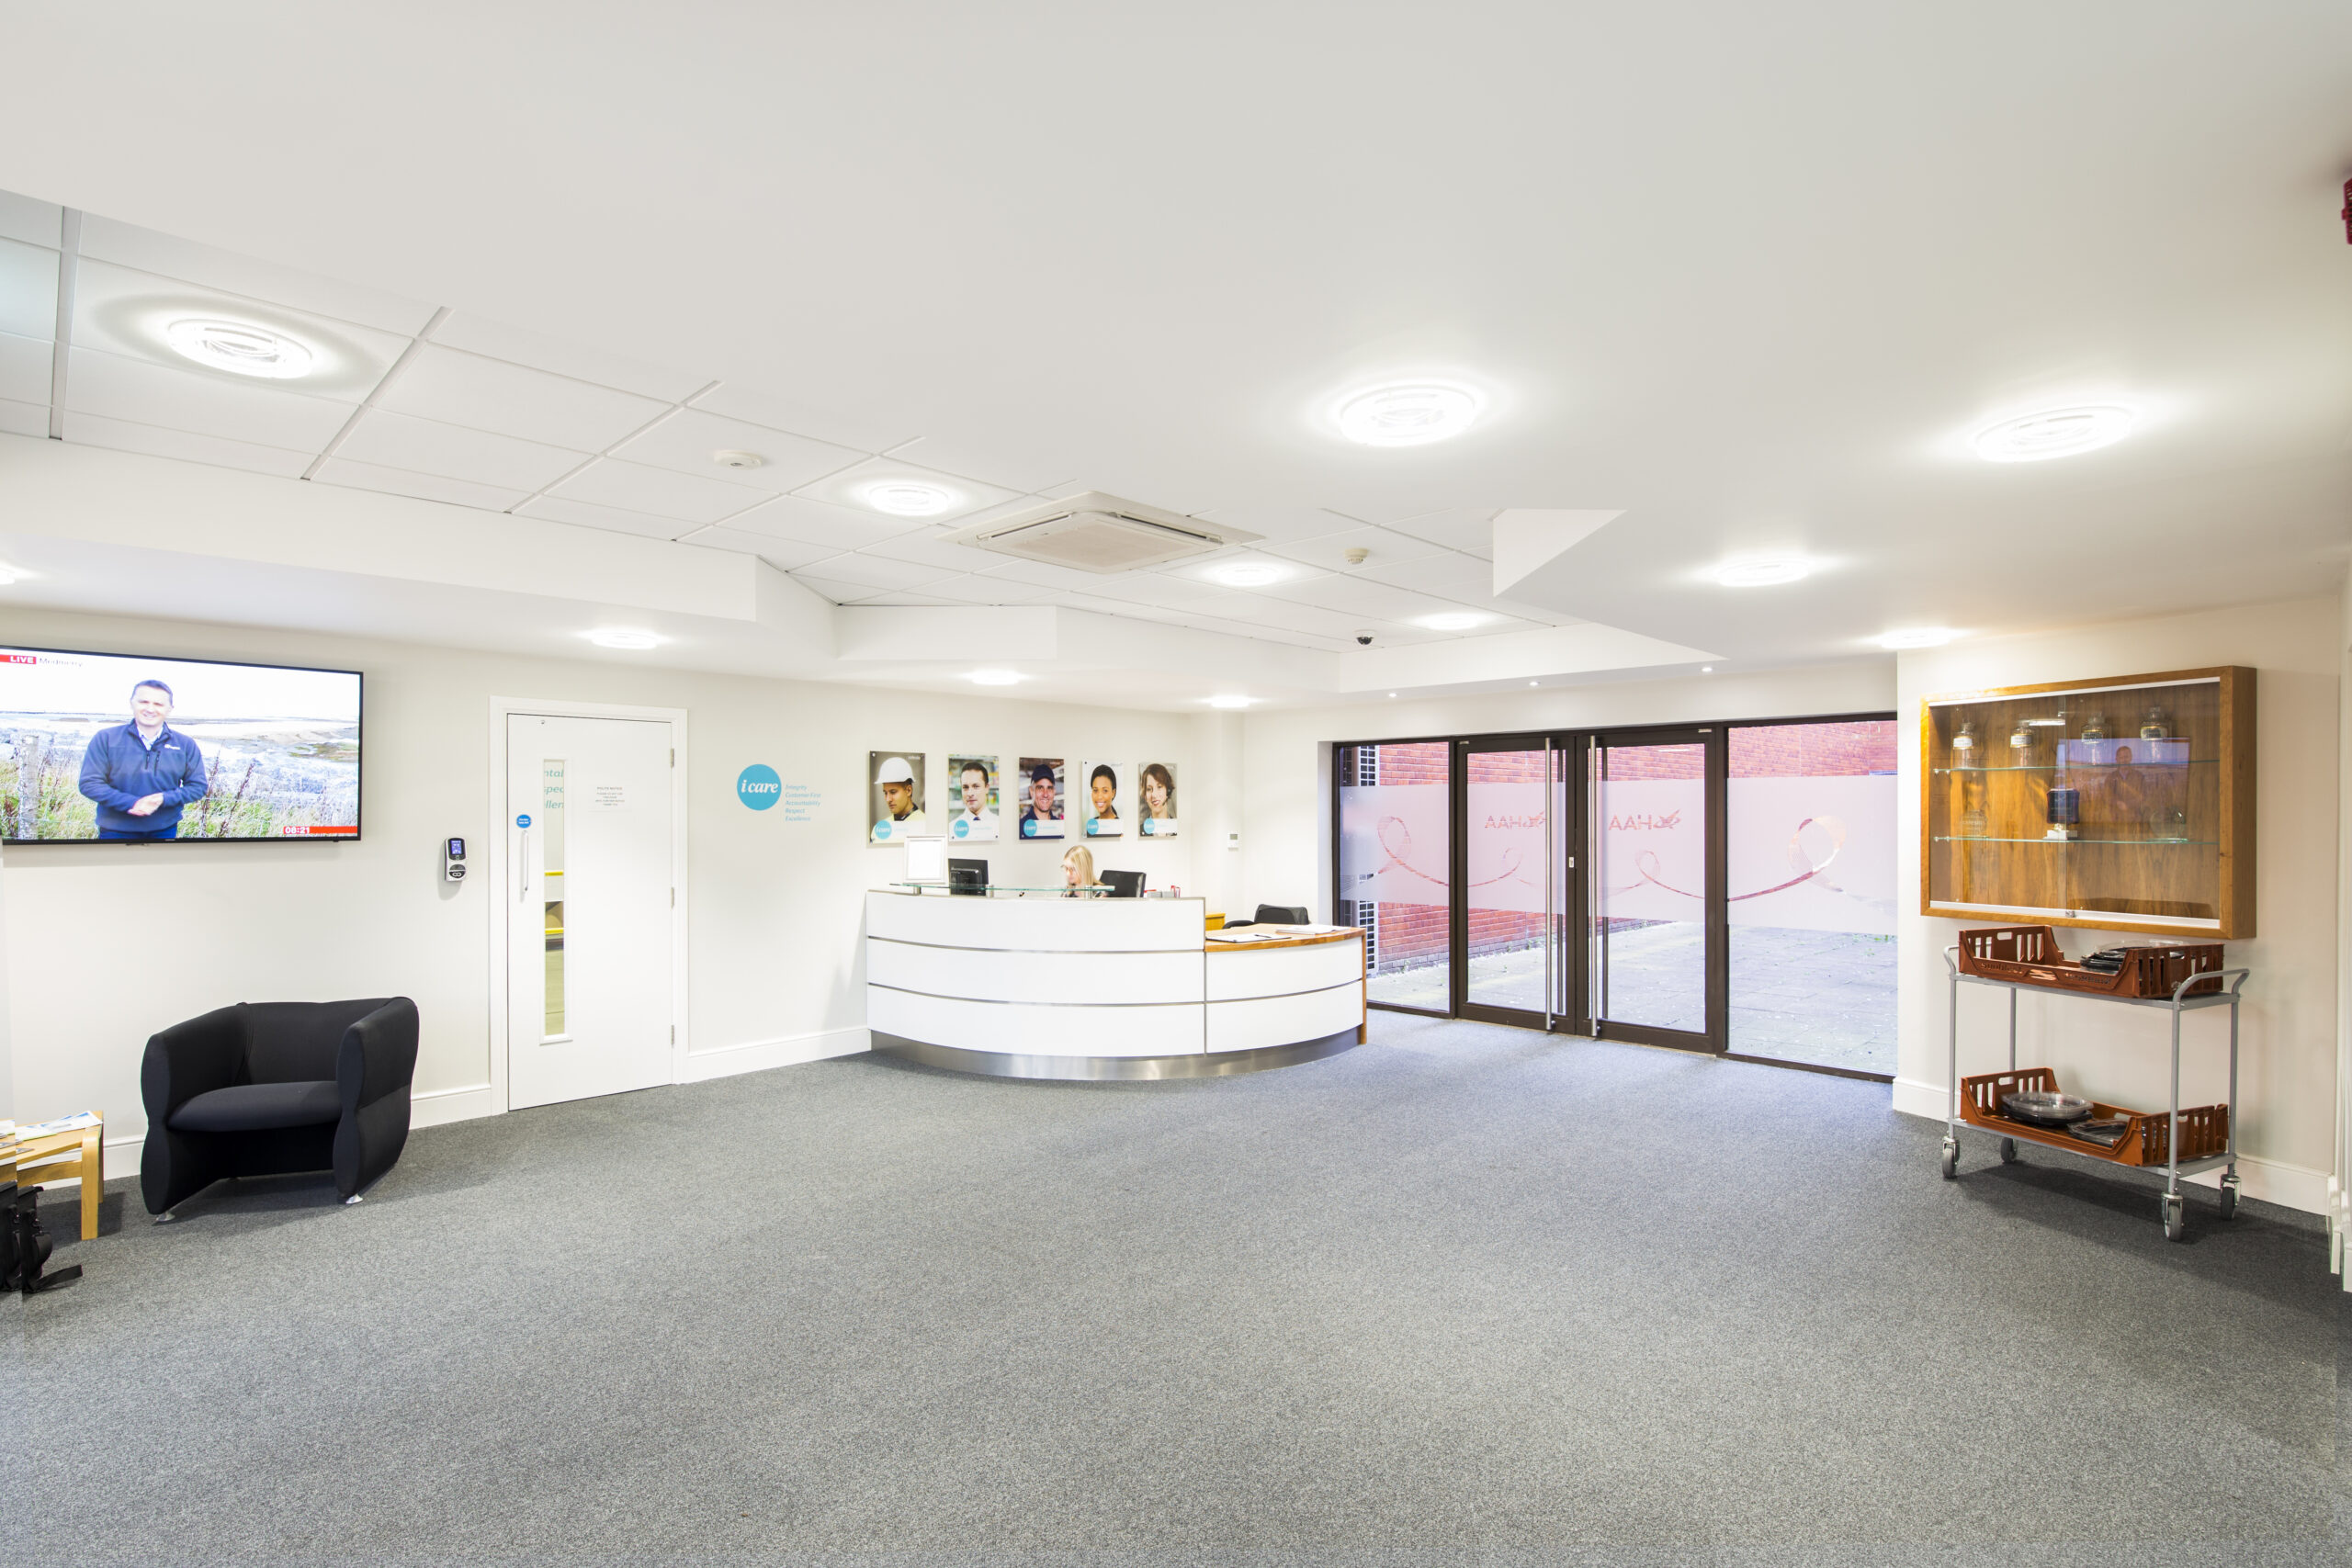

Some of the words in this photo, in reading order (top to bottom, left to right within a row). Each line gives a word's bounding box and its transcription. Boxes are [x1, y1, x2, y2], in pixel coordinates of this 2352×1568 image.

[10, 655, 34, 663] LIVE
[741, 779, 747, 793] i
[747, 782, 779, 794] care
[1484, 815, 1522, 829] AAH
[1608, 814, 1653, 830] AAH
